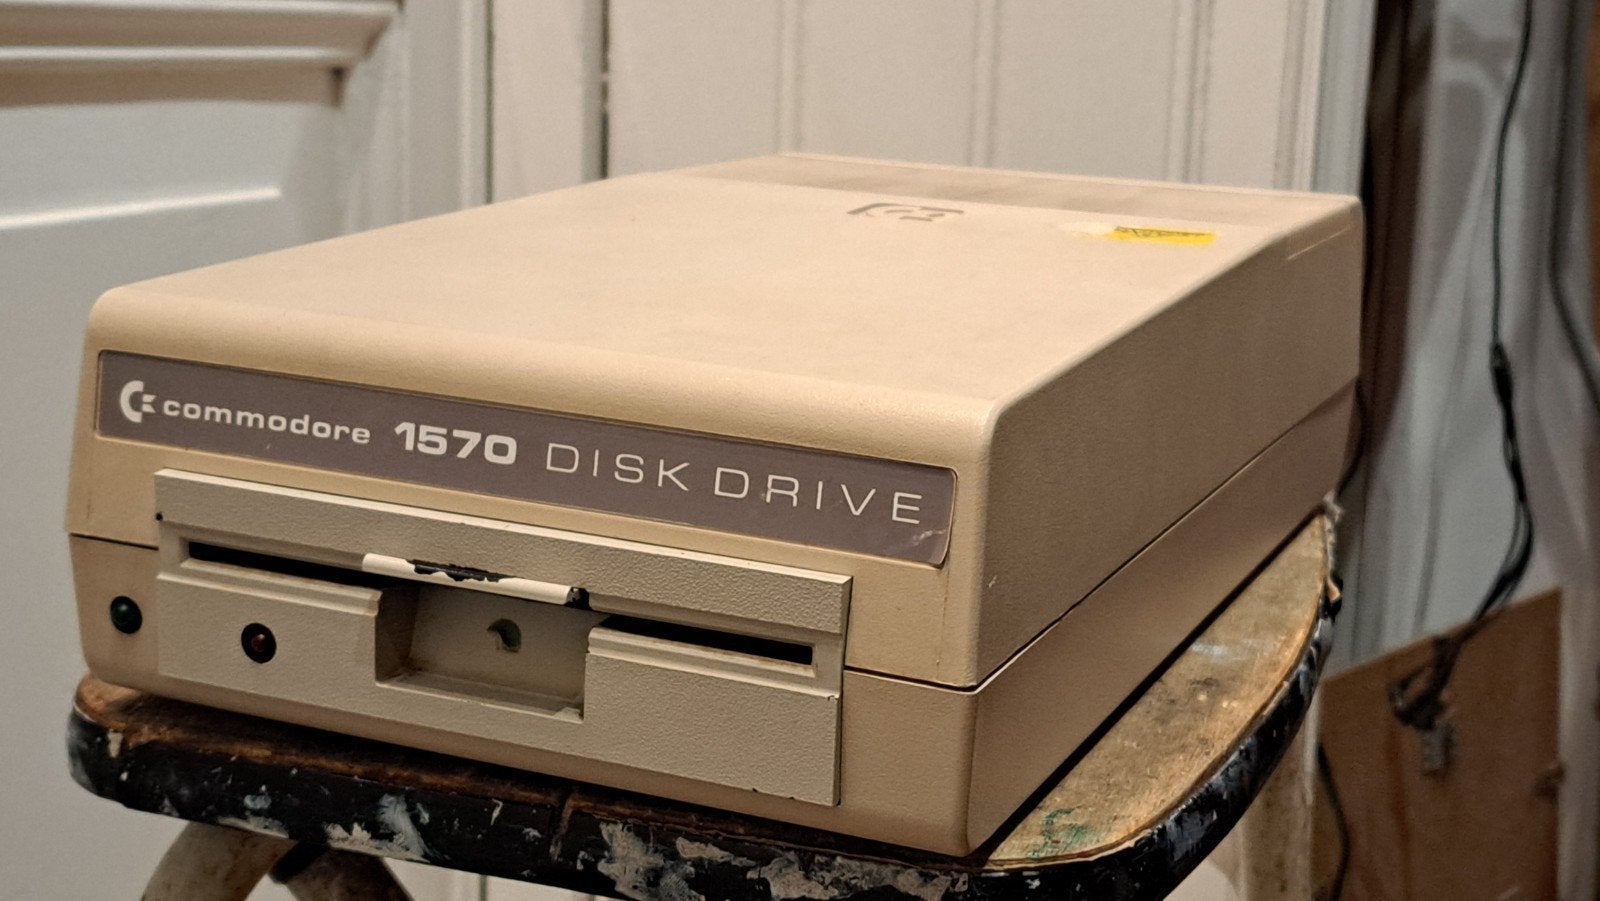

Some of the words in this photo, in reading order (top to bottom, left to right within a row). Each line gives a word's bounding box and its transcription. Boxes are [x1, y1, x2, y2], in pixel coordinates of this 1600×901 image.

[163, 398, 371, 444] commodore
[394, 422, 517, 465] 1570
[546, 442, 690, 491] DISK
[714, 467, 922, 525] DRIVE
